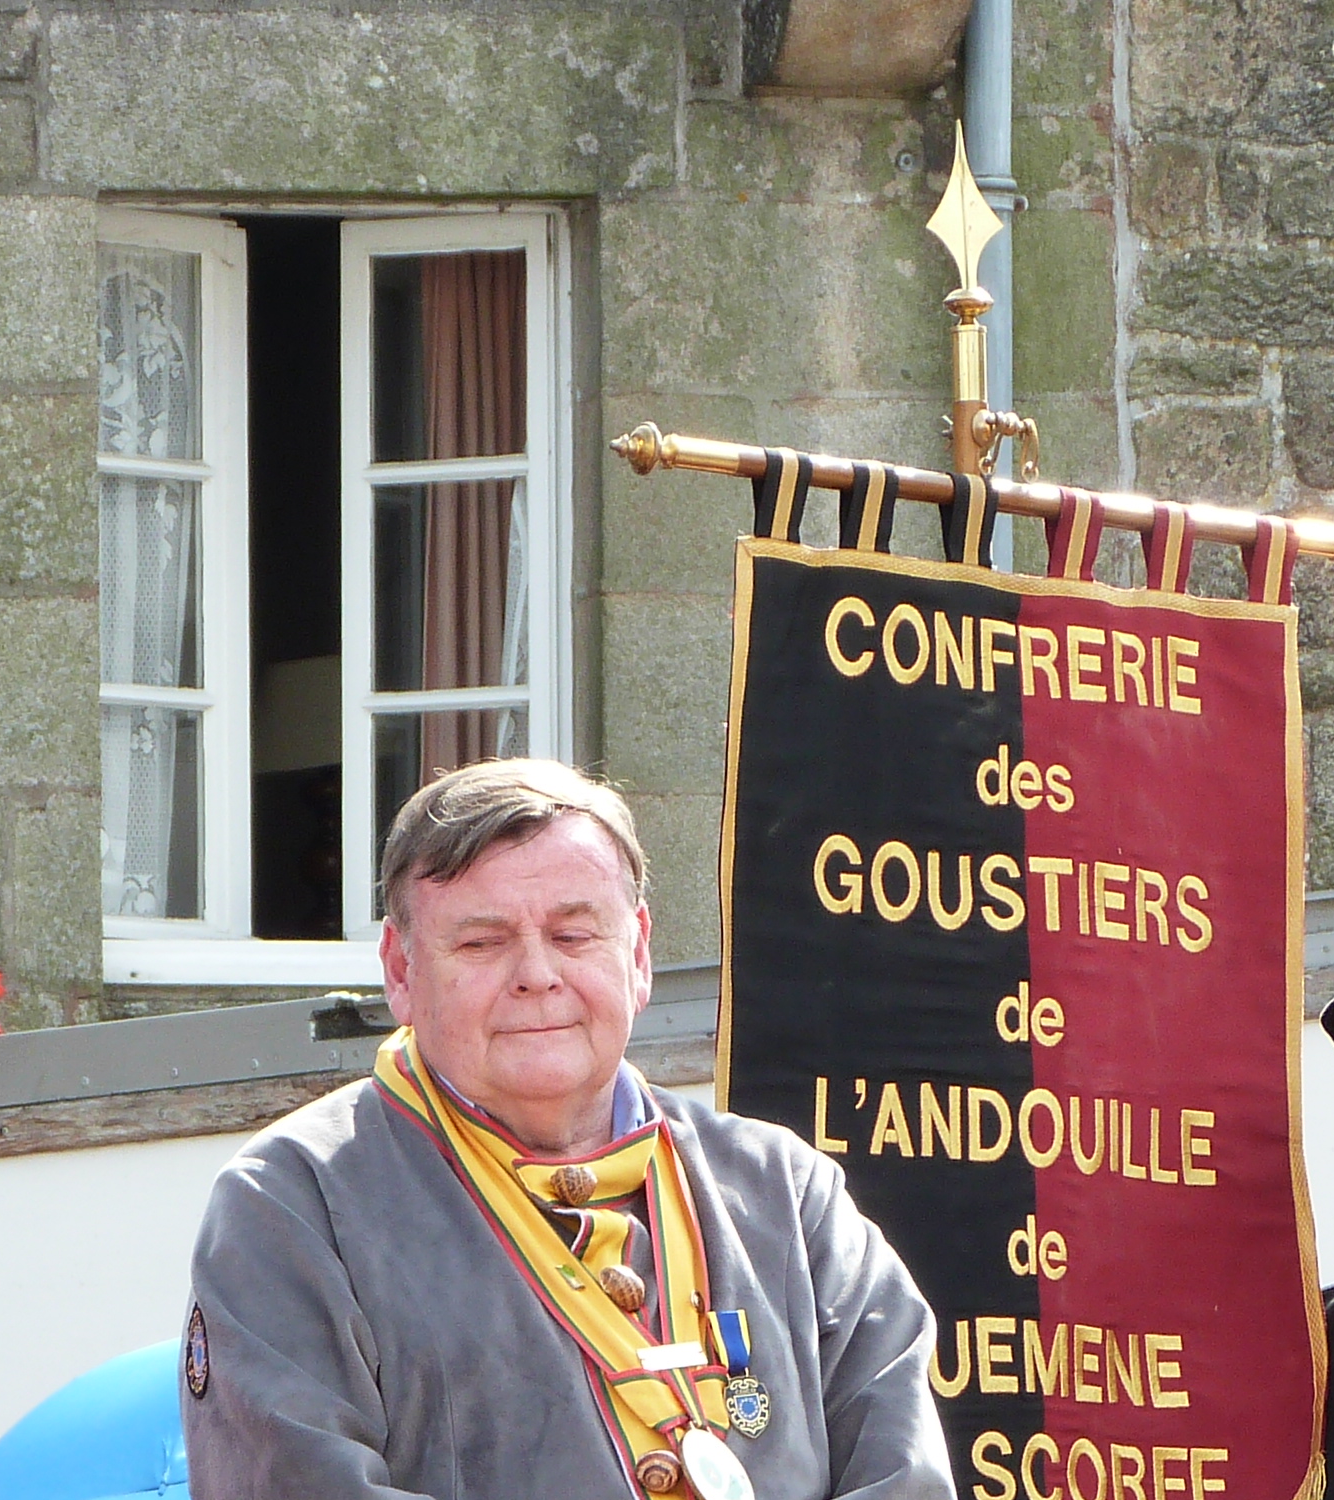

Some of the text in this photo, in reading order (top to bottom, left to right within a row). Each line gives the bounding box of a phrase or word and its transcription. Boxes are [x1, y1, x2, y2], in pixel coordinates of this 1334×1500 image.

[825, 596, 1201, 714] CONFRERIE
[976, 745, 1074, 812] des
[813, 834, 1213, 953] GOUSTIERS
[996, 981, 1065, 1047] de
[814, 1076, 1216, 1186] L'ANDOUILLE
[1007, 1214, 1067, 1280] de
